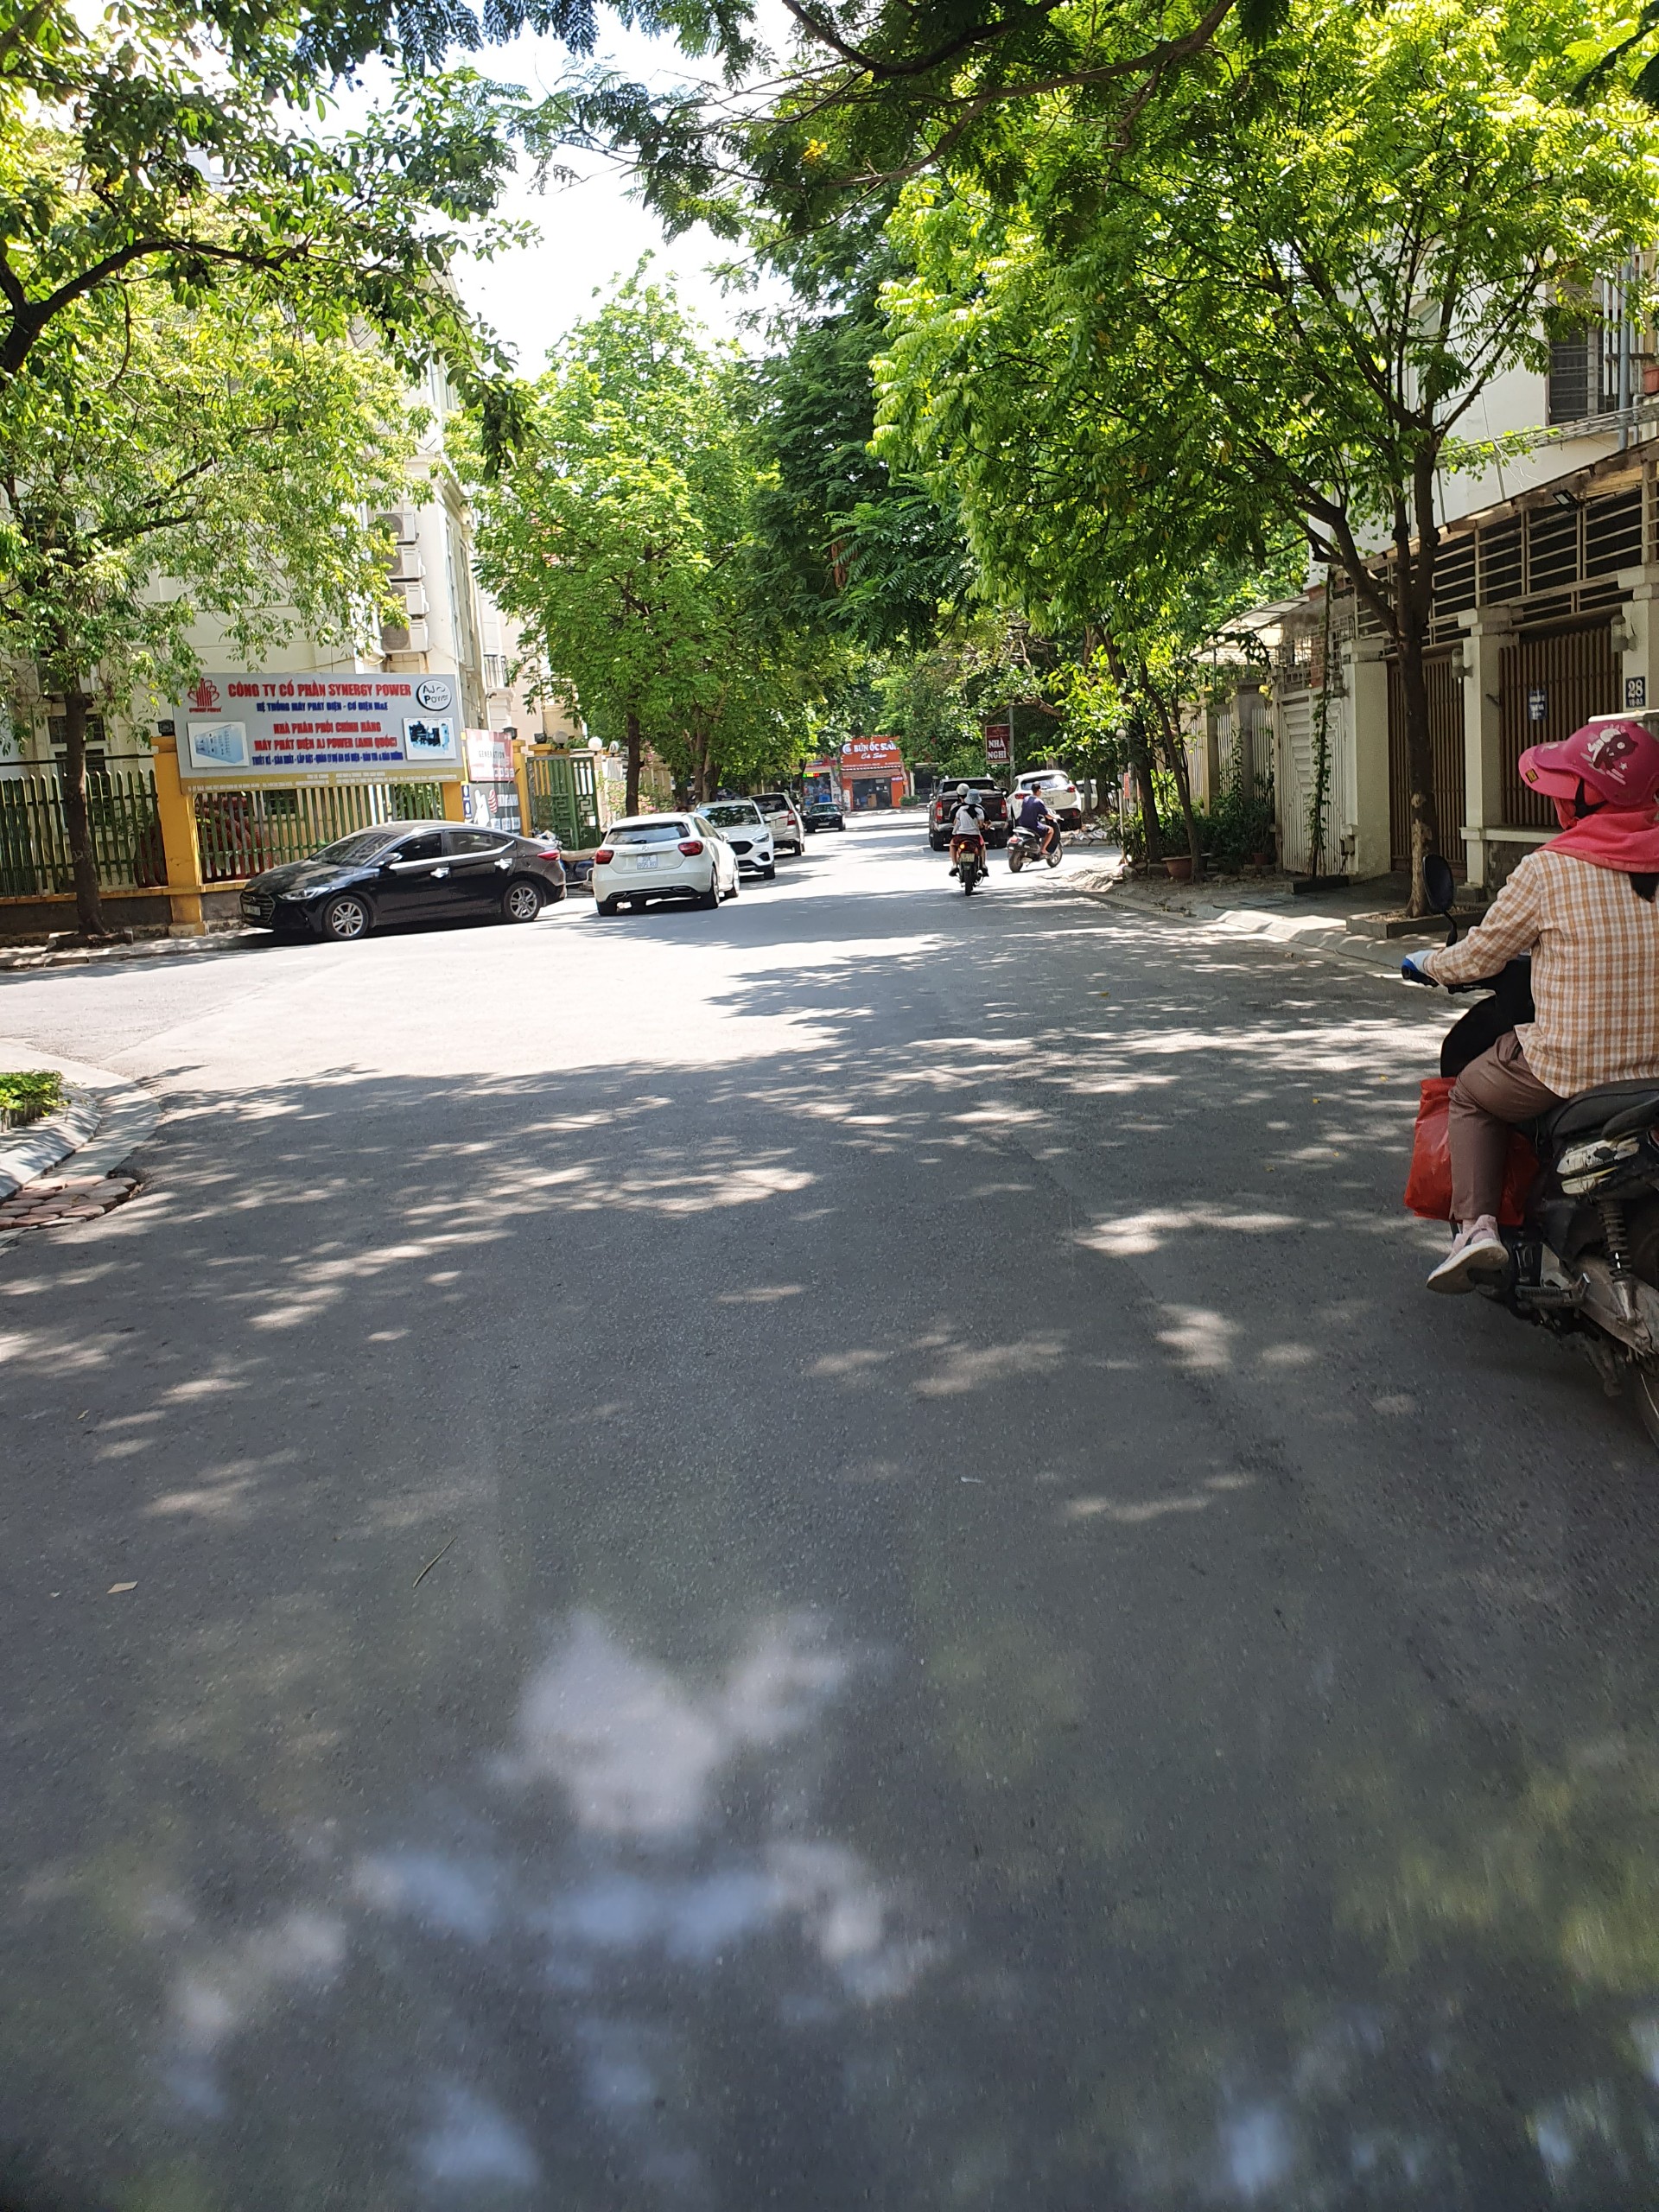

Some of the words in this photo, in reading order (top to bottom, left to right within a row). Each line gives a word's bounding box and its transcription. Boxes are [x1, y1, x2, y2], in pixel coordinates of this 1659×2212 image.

[228, 681, 259, 697] CÔNG
[262, 683, 276, 696] TY
[328, 683, 372, 696] SYNERGY
[376, 683, 412, 696] POWER
[1628, 679, 1643, 697] 28
[423, 694, 449, 704] Power
[291, 701, 306, 711] MÁY
[308, 701, 324, 711] PHÁT
[273, 721, 290, 734] NHÀ
[291, 721, 314, 734] PHÂN
[254, 738, 271, 751] MÁY
[274, 737, 295, 751] PHÁT
[327, 737, 353, 749] POWER
[854, 742, 869, 753] BÚN
[869, 741, 880, 751] ỐC
[988, 737, 1005, 748] NHÀ
